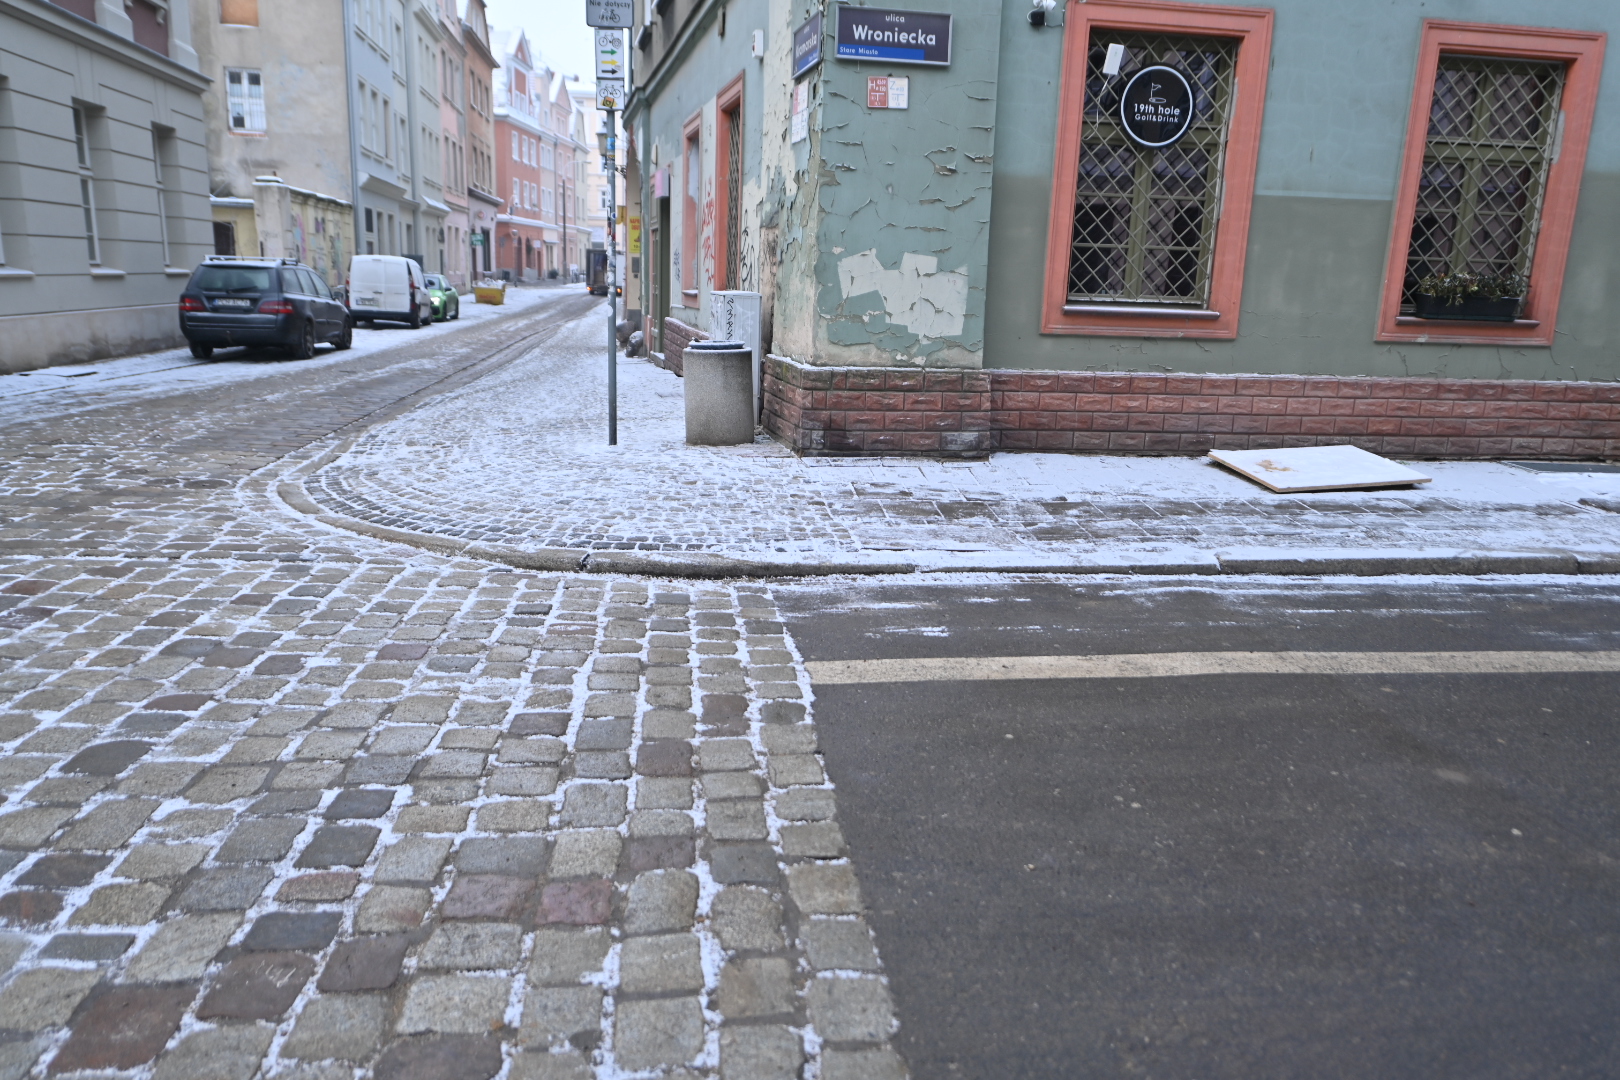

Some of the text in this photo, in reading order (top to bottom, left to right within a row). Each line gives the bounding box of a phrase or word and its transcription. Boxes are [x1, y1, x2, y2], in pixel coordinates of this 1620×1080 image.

[605, 0, 630, 9] dotyczy
[885, 13, 905, 23] ulica
[852, 24, 936, 45] Wroniecka
[839, 46, 879, 55] Stare Miasto
[869, 80, 875, 90] H
[1134, 103, 1180, 115] 19th hole
[1134, 113, 1179, 123] Golf&Drink
